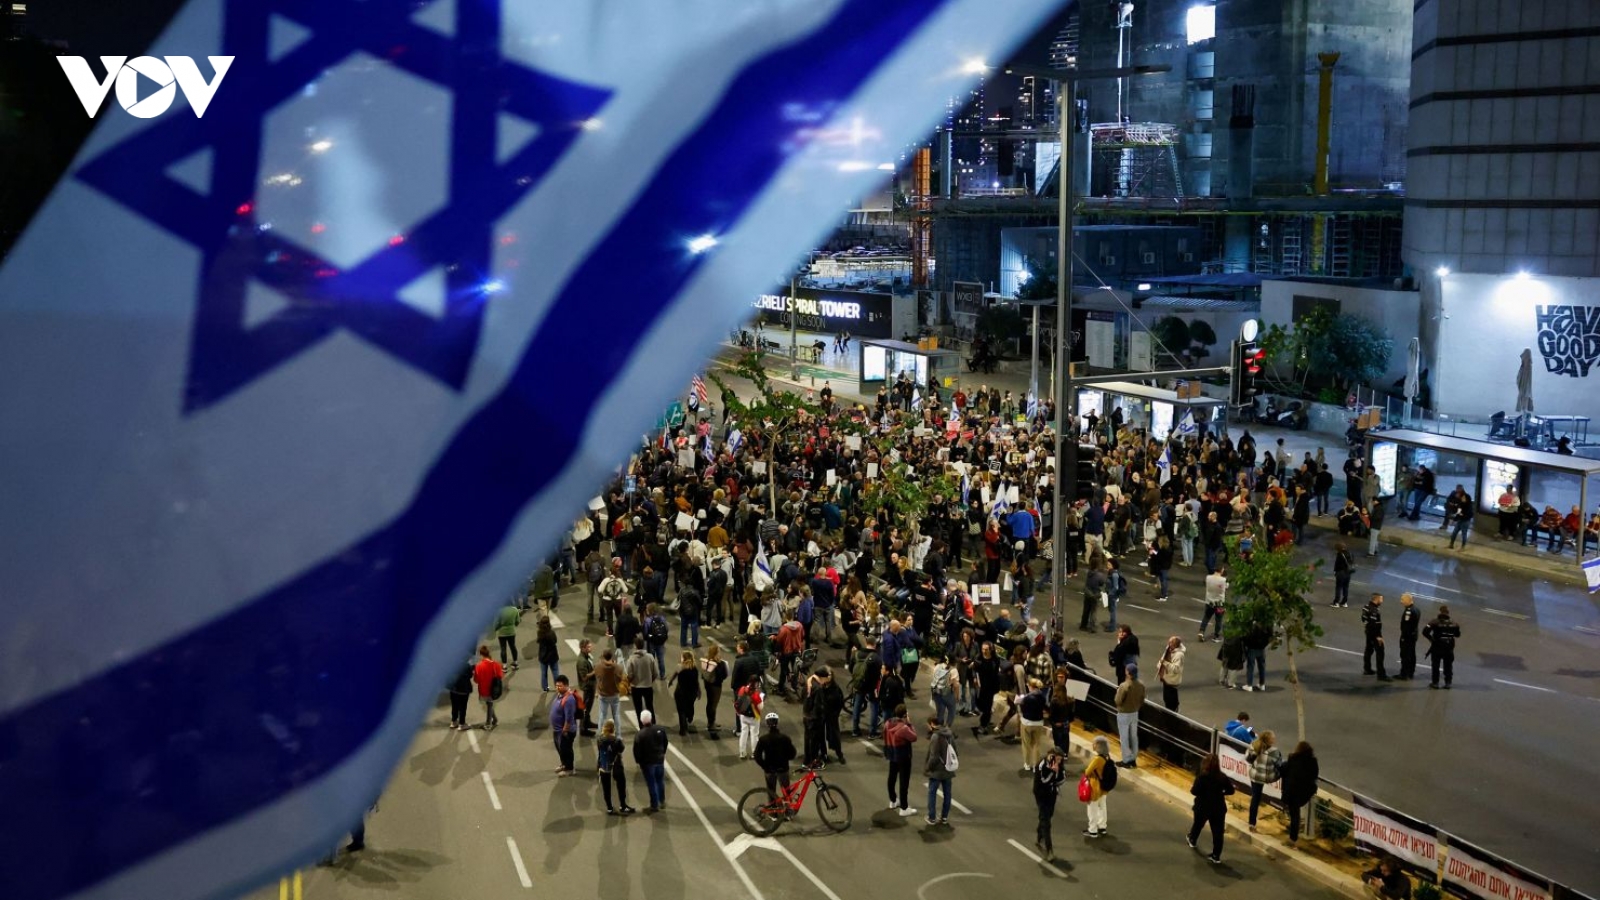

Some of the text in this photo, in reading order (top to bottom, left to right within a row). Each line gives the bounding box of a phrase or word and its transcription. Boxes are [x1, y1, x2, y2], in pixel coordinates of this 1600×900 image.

[819, 299, 861, 319] TOWER
[806, 315, 826, 329] SOON
[1537, 329, 1600, 359] GOOD
[1544, 354, 1597, 378] DAY
[1488, 875, 1511, 900] אותם
